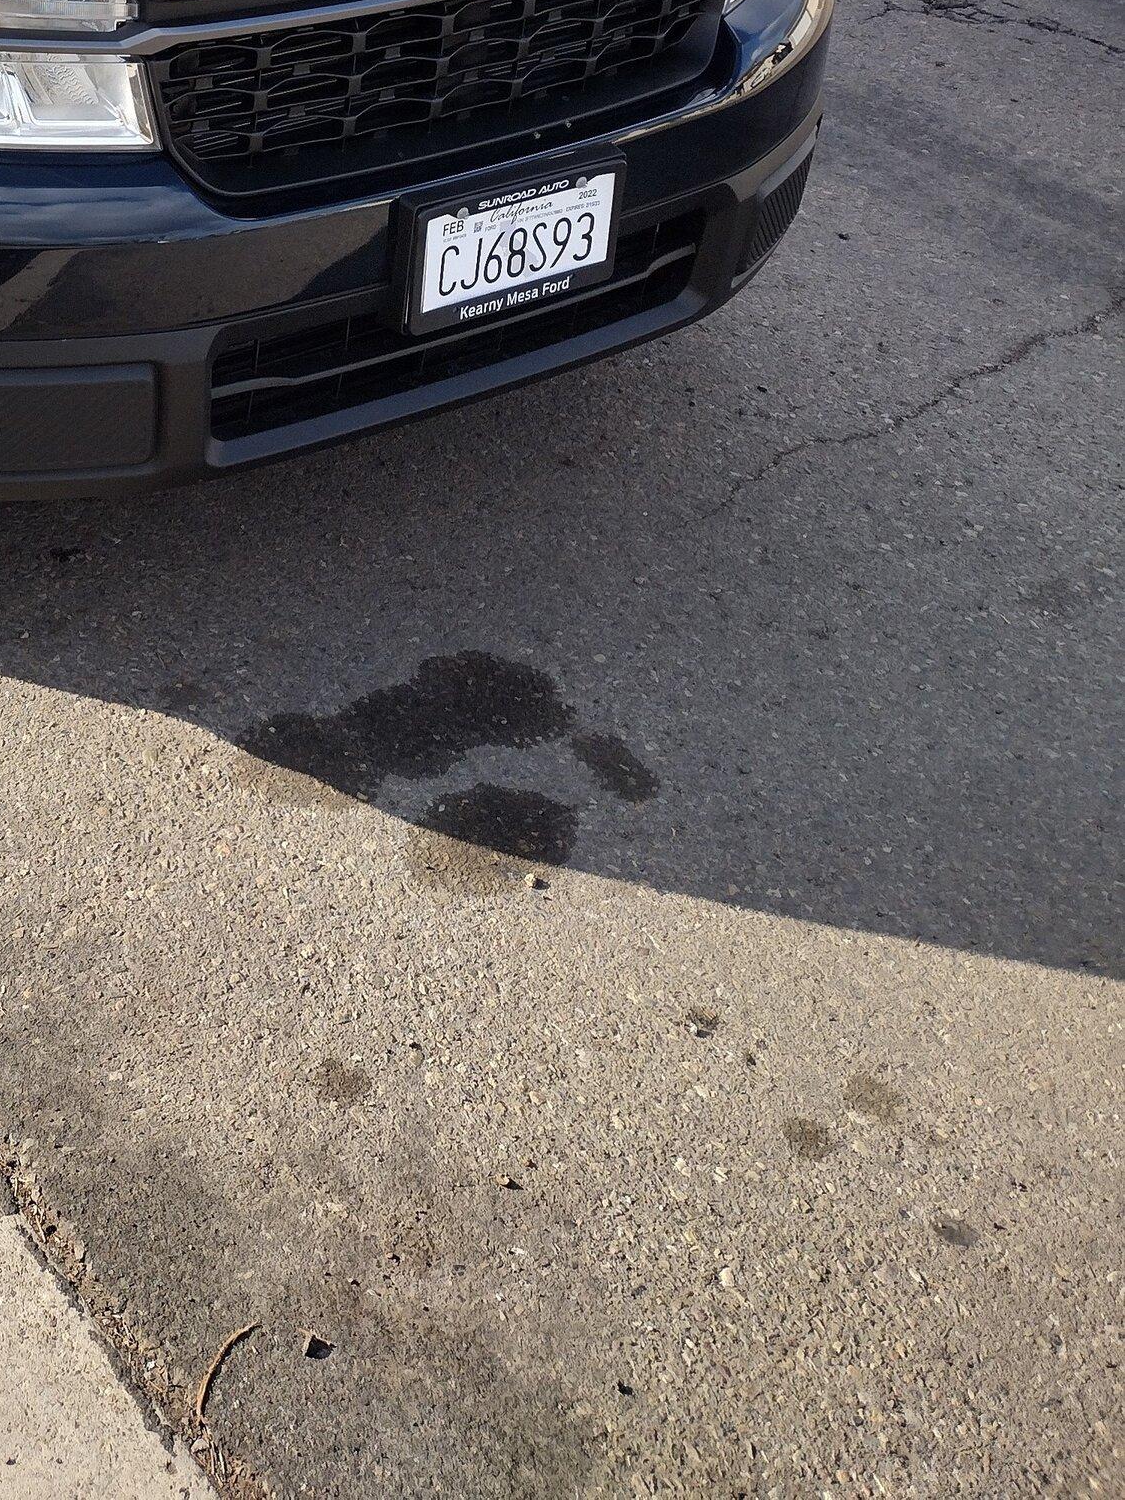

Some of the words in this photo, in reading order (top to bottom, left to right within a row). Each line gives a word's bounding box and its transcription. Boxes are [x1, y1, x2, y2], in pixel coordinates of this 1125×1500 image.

[477, 188, 537, 211] SUNROAD
[540, 179, 570, 194] AUTO
[578, 188, 598, 200] 2022
[490, 200, 554, 225] California
[442, 220, 465, 237] FEB
[439, 212, 595, 296] CJ68S93
[460, 297, 504, 320] Kearny
[506, 286, 539, 306] Mesa
[542, 278, 571, 296] Ford
